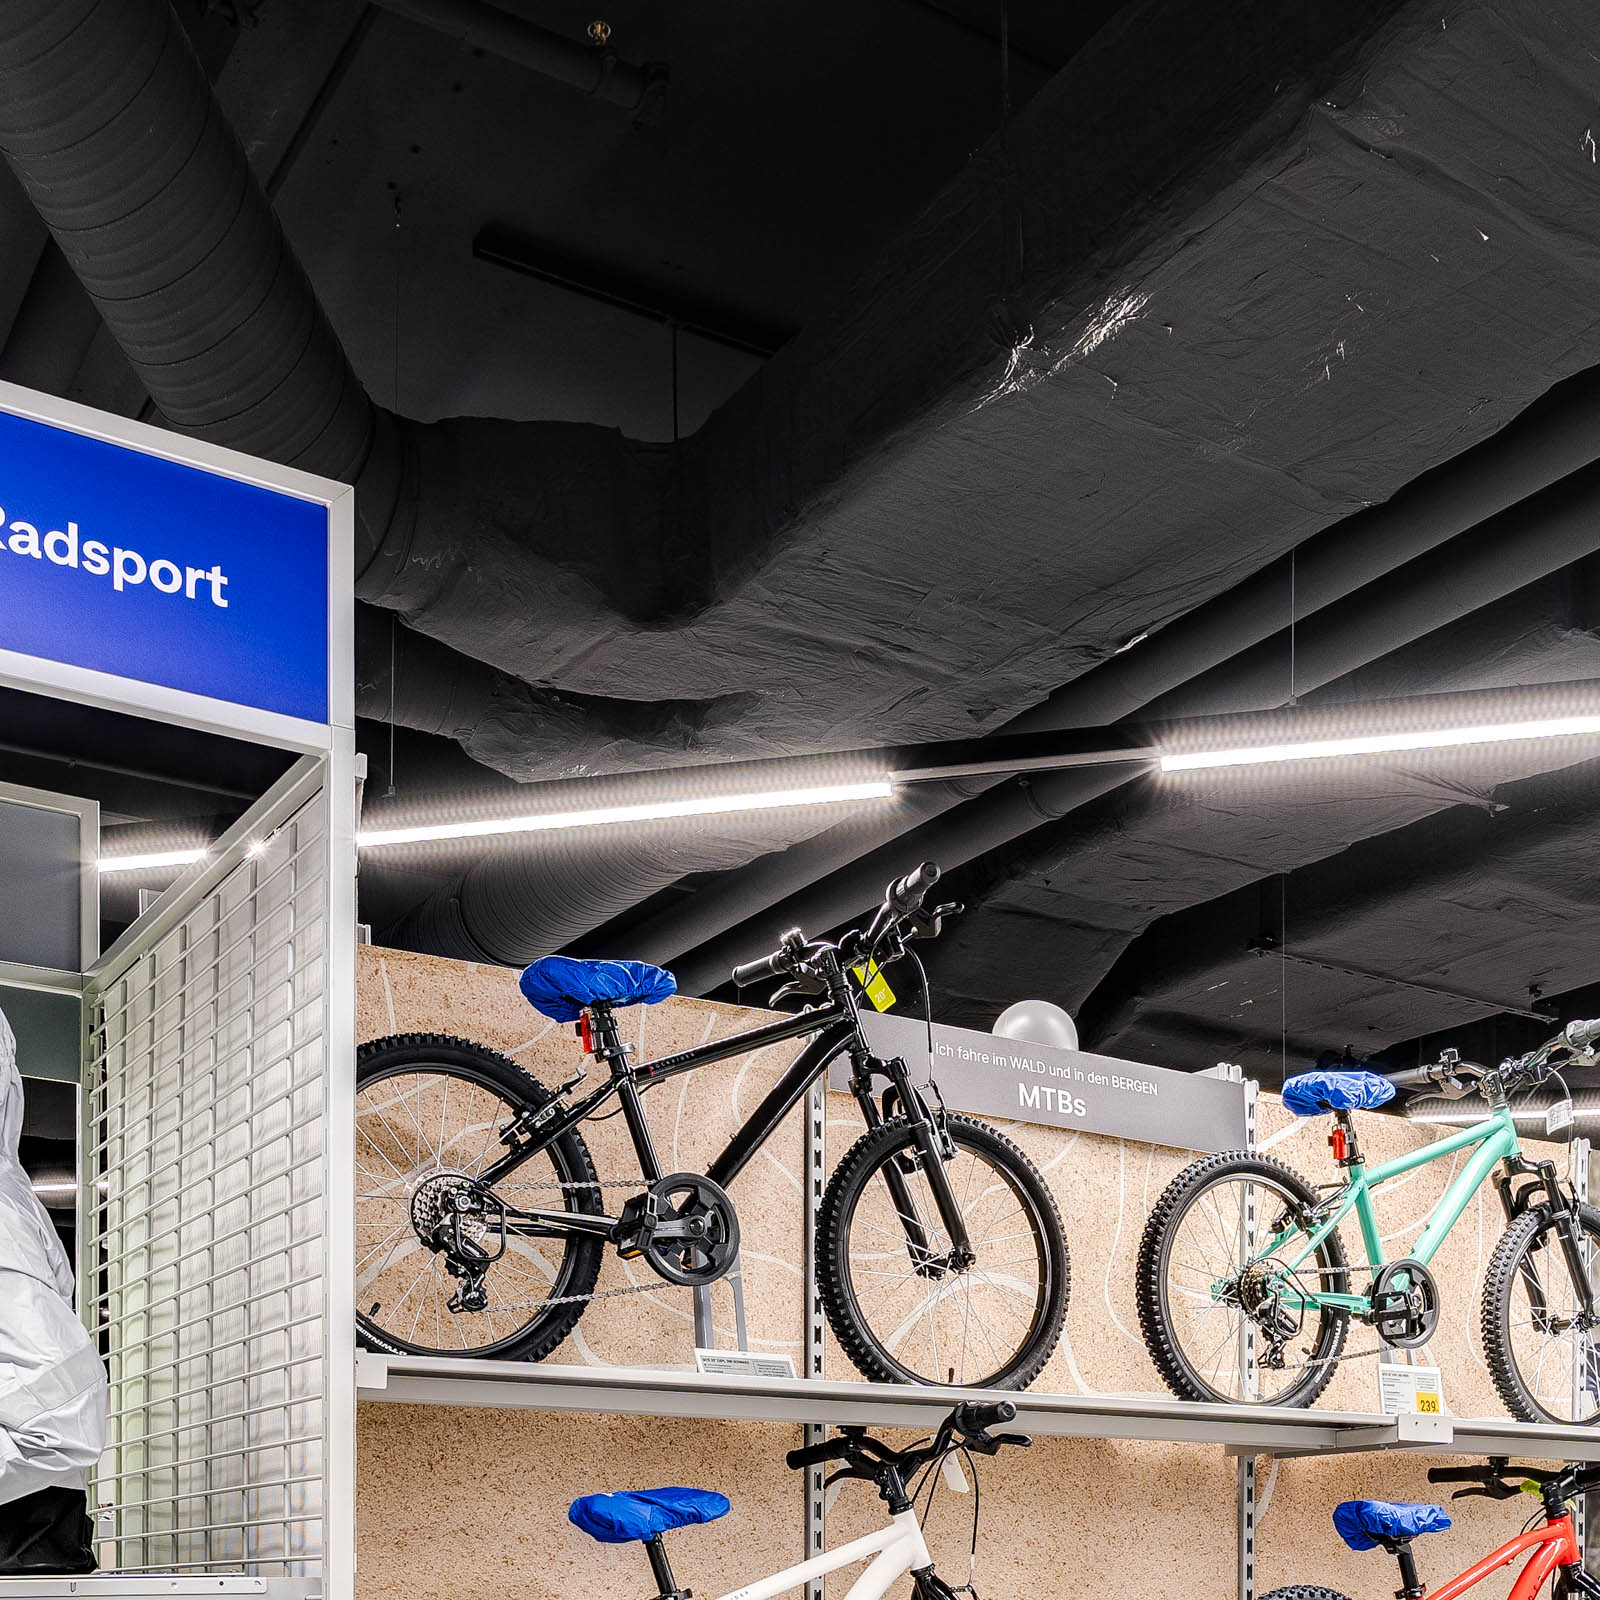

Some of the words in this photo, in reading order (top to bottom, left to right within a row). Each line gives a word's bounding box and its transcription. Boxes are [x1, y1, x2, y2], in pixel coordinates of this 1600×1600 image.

[935, 1042, 954, 1057] Ich
[958, 1045, 990, 1064] fahre
[992, 1054, 1007, 1067] im
[1010, 1055, 1046, 1074] WALD
[1050, 1063, 1071, 1079] und
[1074, 1068, 1085, 1082] in
[1087, 1071, 1109, 1086] den
[1111, 1075, 1158, 1096] BERGEN
[1018, 1082, 1087, 1117] MTBs
